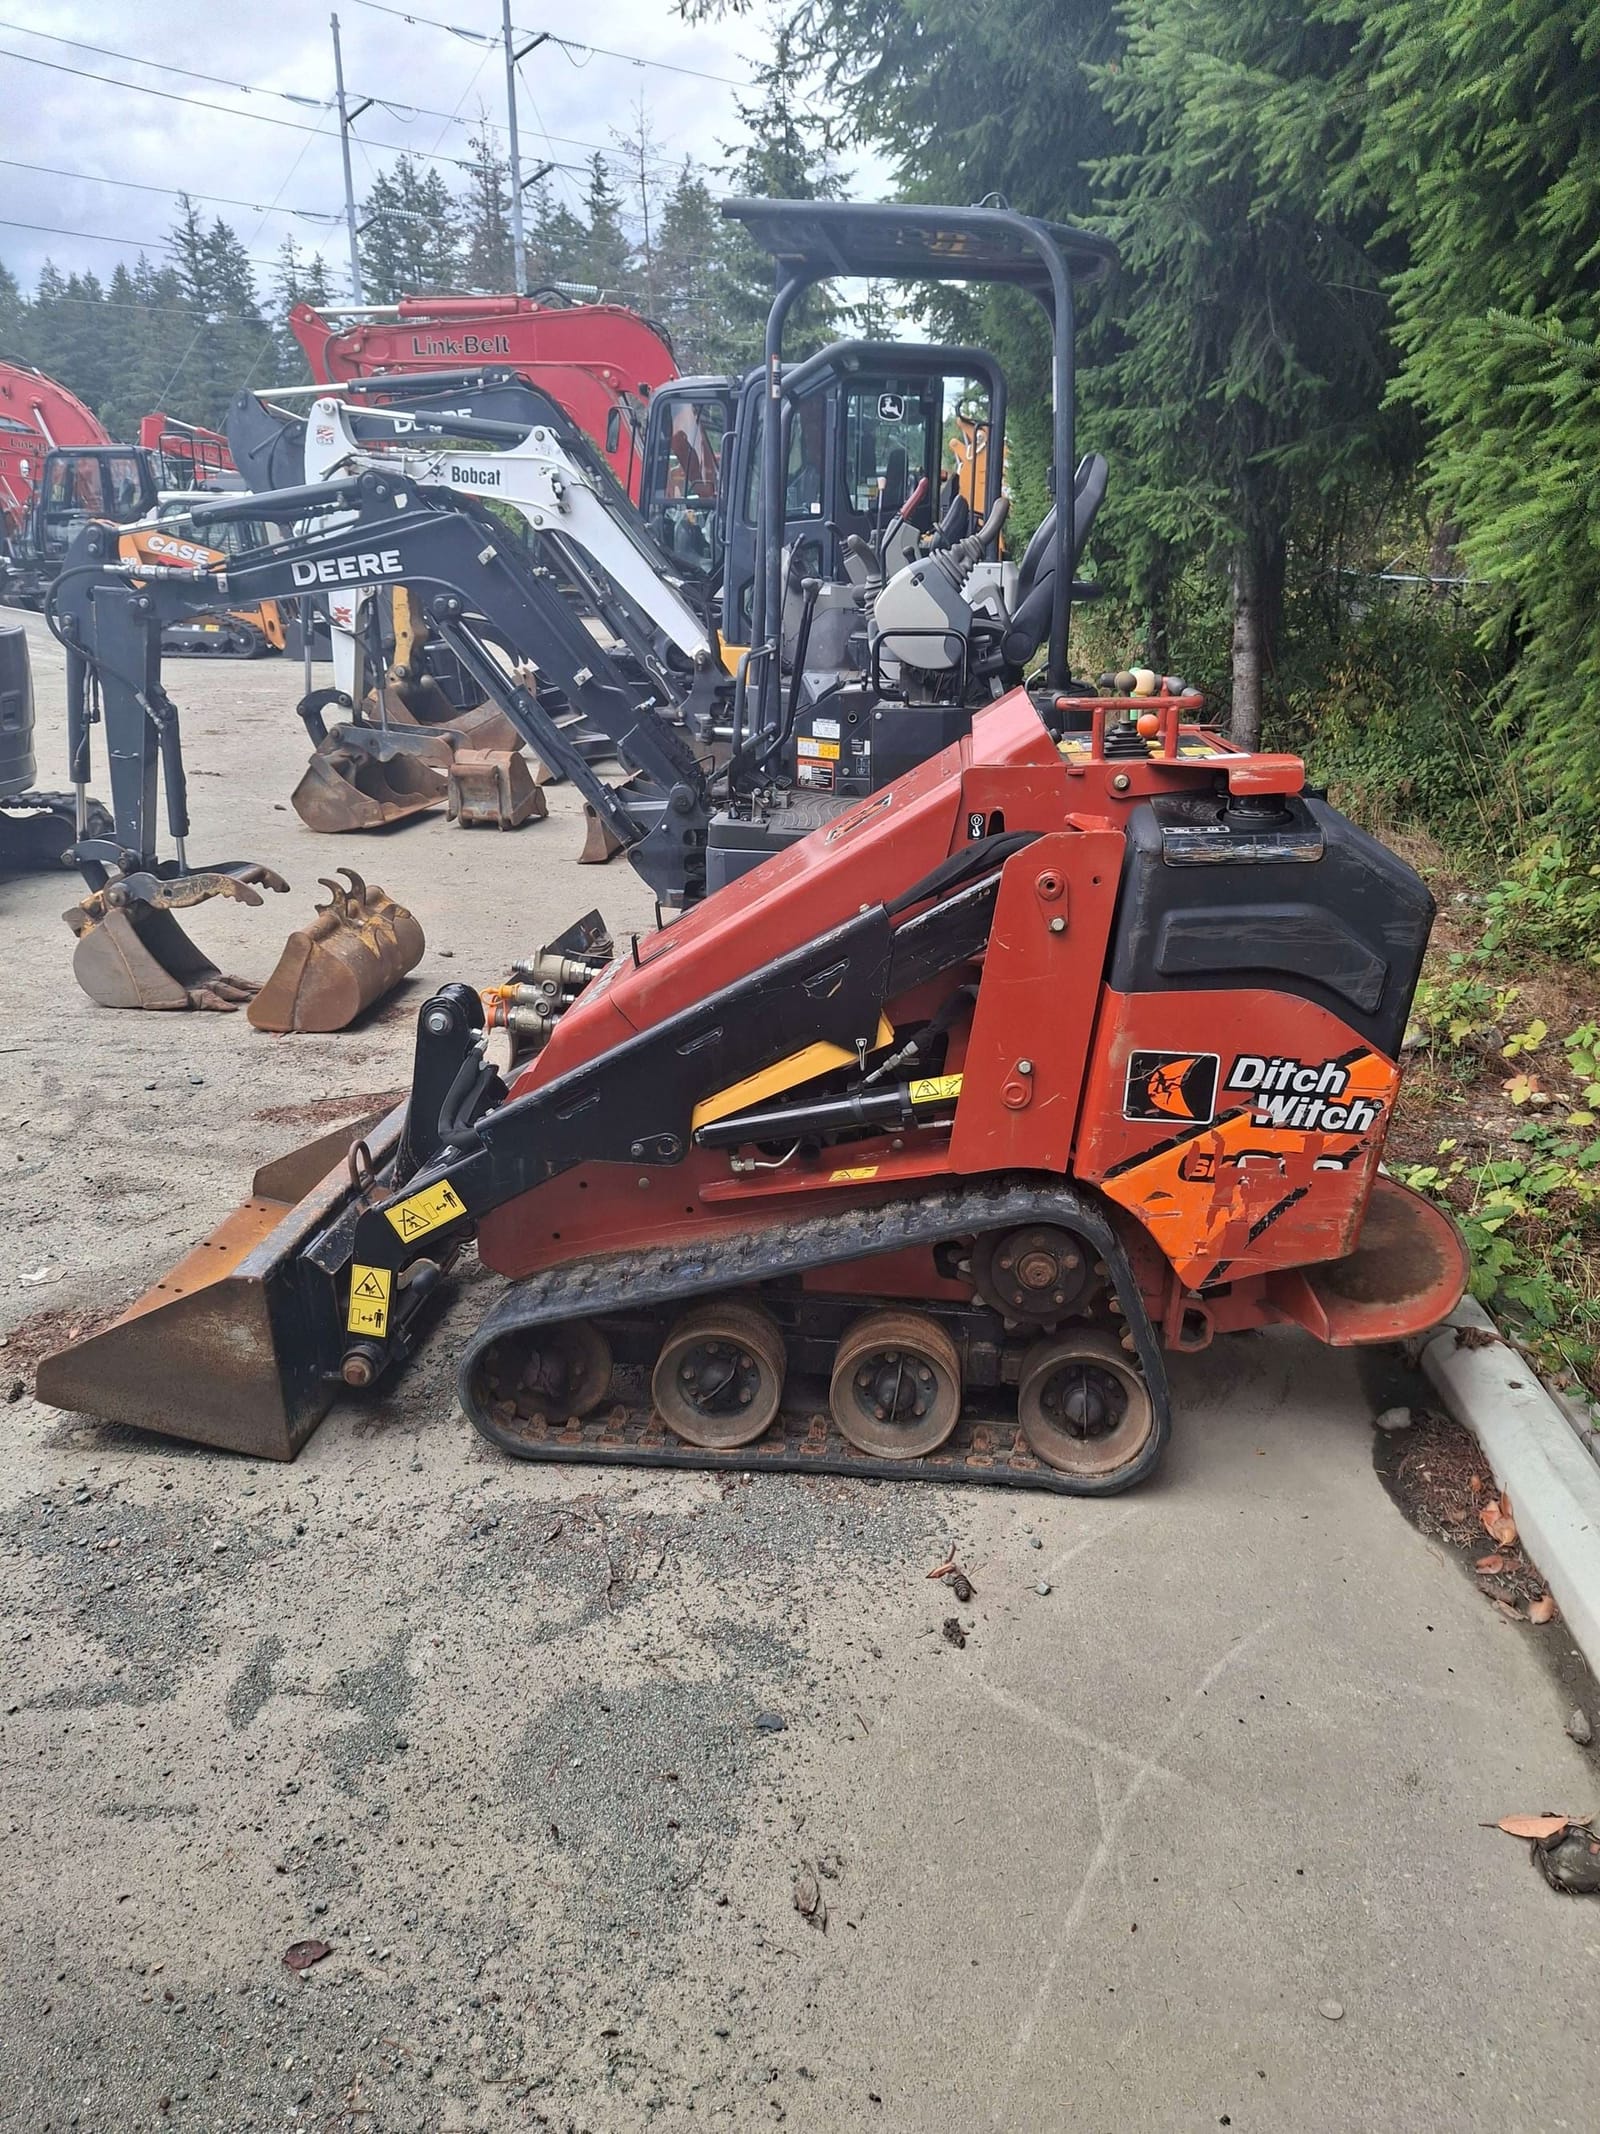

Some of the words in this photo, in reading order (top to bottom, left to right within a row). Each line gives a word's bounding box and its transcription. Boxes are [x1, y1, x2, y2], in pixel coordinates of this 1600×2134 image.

[451, 465, 501, 486] Bobcat
[148, 535, 210, 566] CASE
[291, 549, 404, 587] DEERE
[1228, 1057, 1347, 1095] Ditch
[1254, 1093, 1376, 1132] Witch
